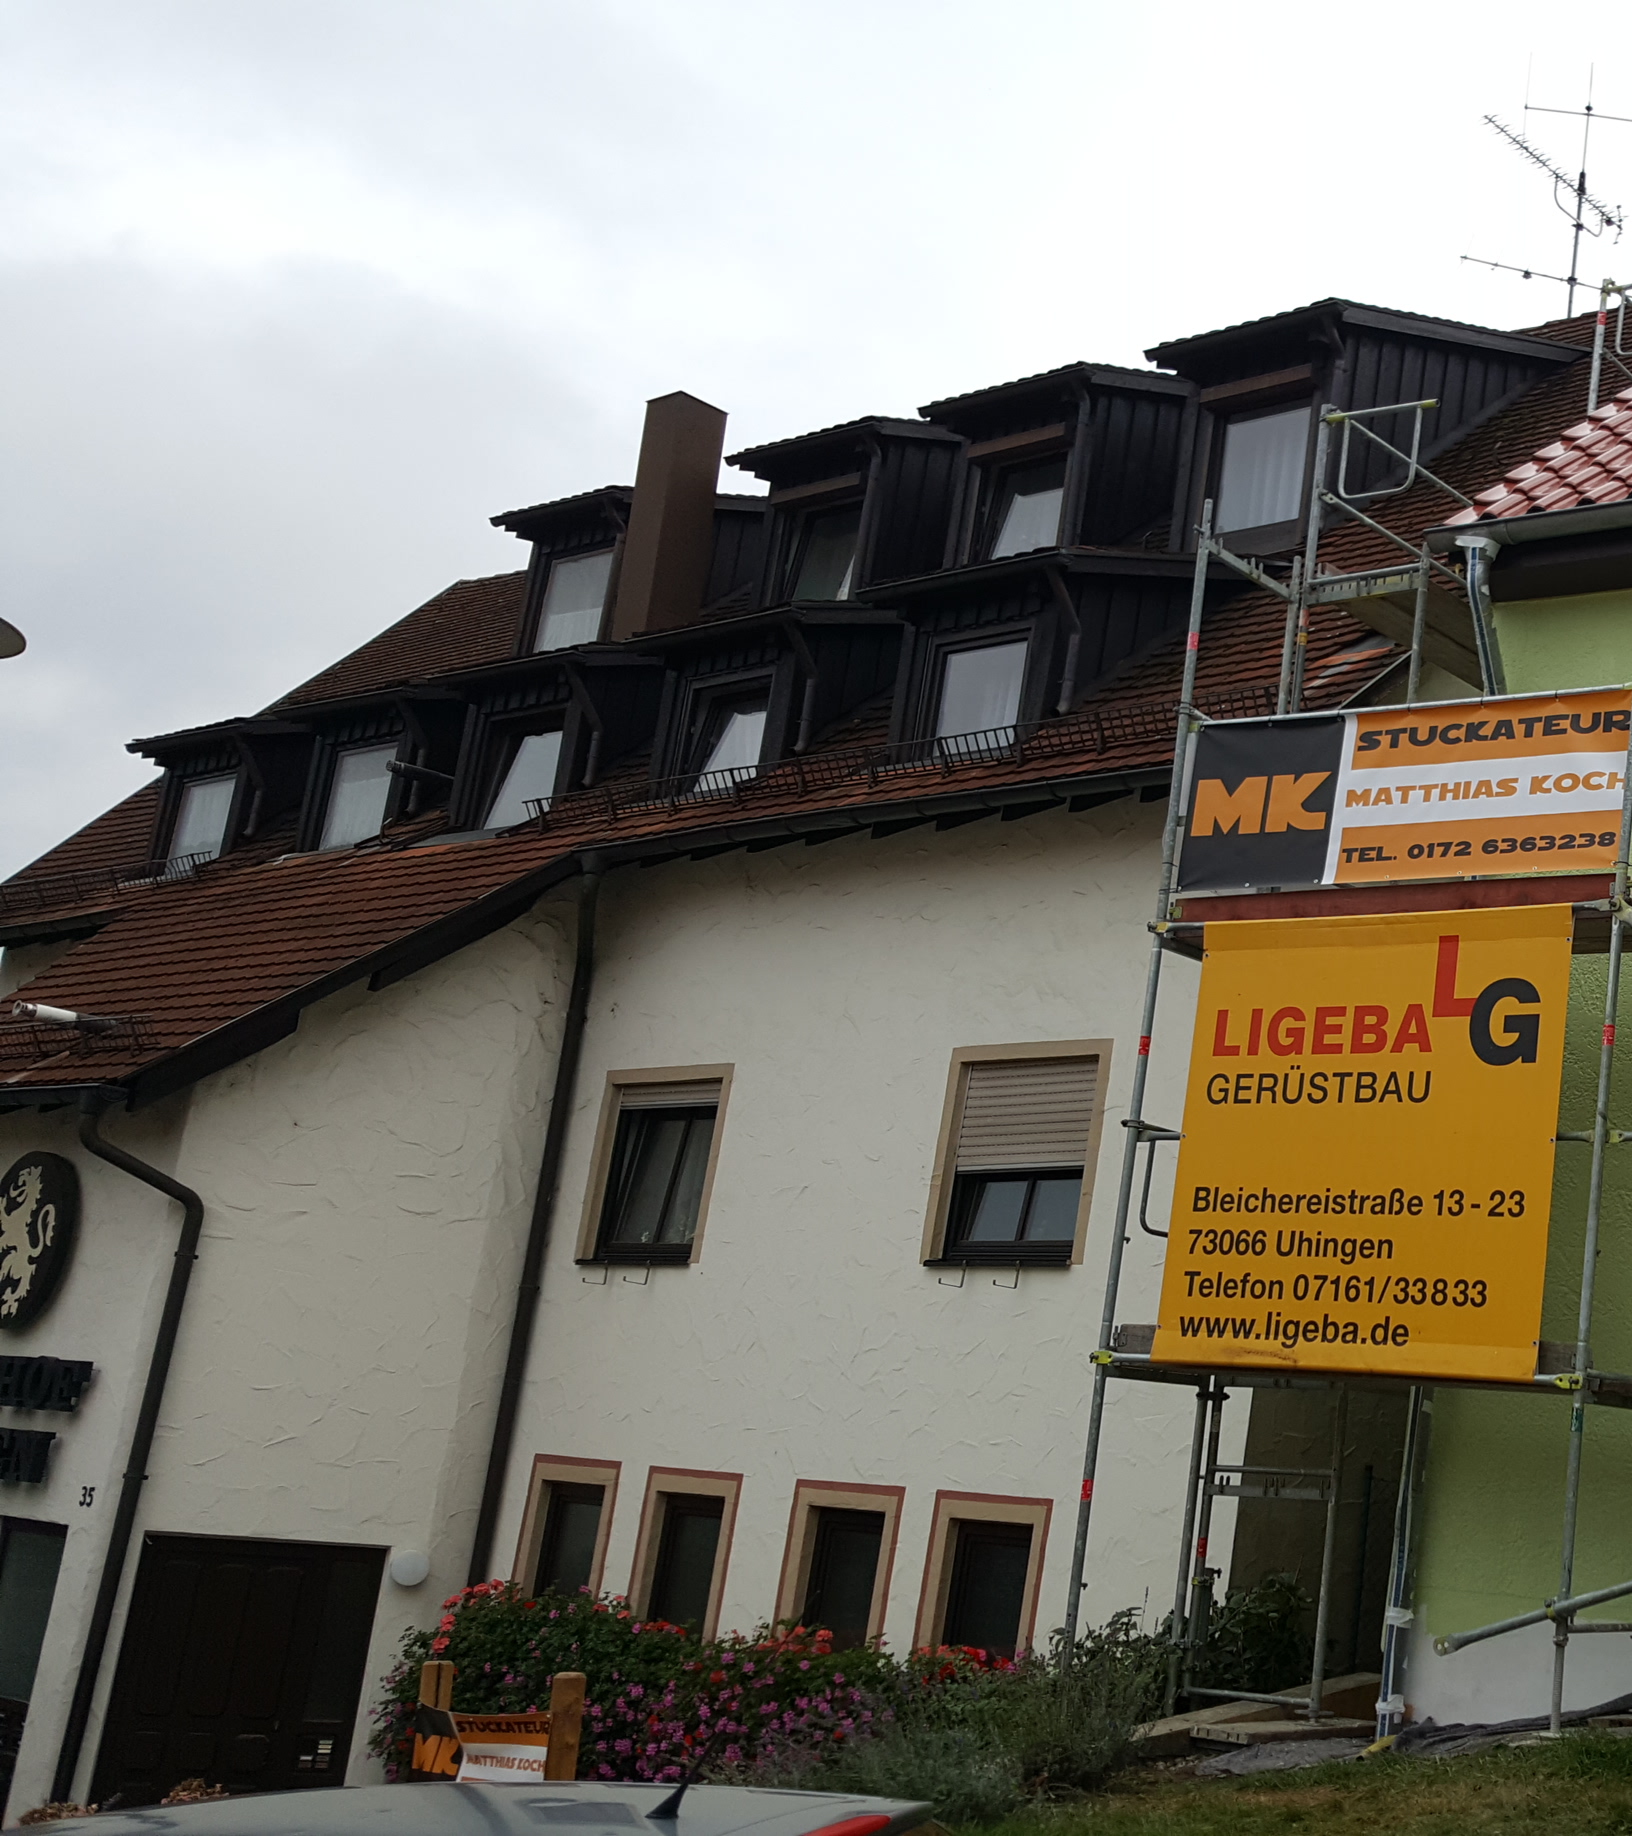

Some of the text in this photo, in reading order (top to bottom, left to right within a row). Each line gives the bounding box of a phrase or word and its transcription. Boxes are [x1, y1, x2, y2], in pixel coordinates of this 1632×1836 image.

[1357, 709, 1631, 752] STUCKATEUR
[1190, 771, 1332, 837] MK
[1345, 770, 1626, 808] MATTHIAS KOCH
[1342, 831, 1617, 864] TEL. 0172 6363238
[1211, 1003, 1433, 1057] LIGEBA
[1206, 1065, 1432, 1105] GERÜSTBAU
[1192, 1186, 1424, 1216] Bleichereistraße
[1188, 1229, 1394, 1264] 73066 Uhingen
[1183, 1271, 1488, 1308] Telefon 07161/33833
[1179, 1311, 1410, 1348] www.ligeba.de
[79, 1486, 95, 1507] 35
[412, 1733, 460, 1776] MK
